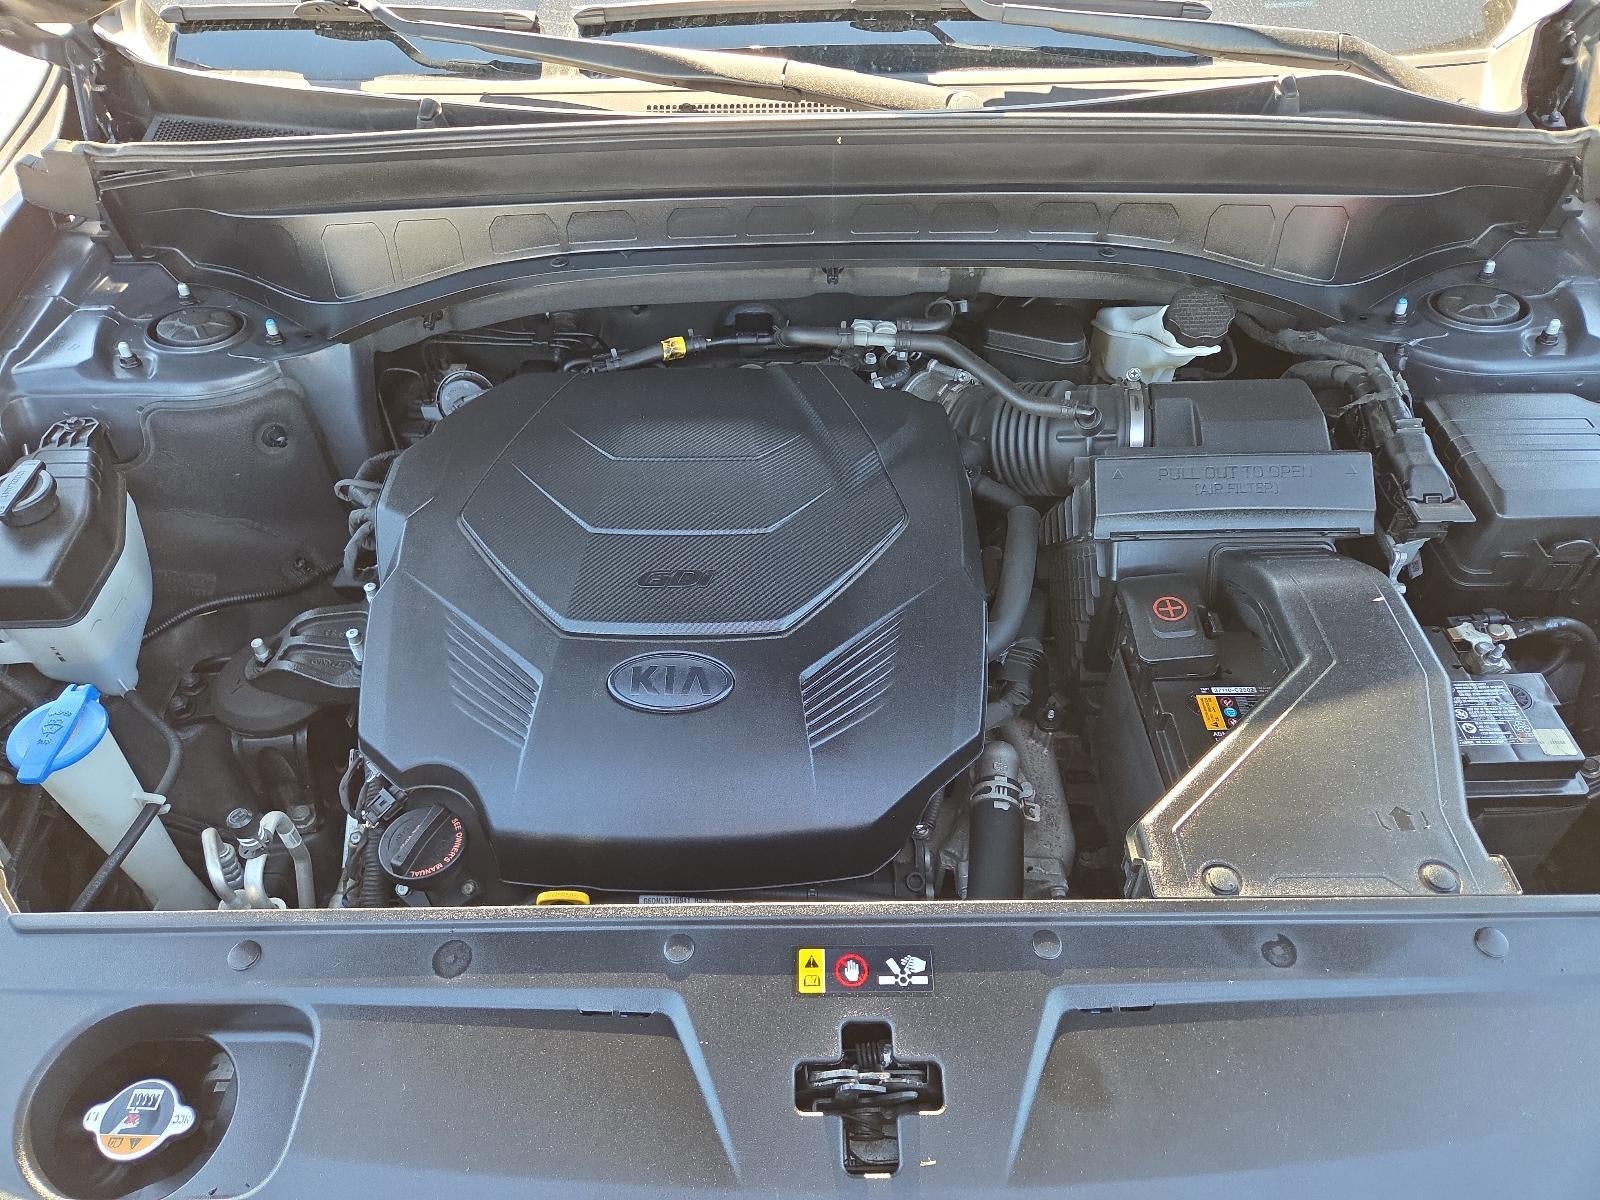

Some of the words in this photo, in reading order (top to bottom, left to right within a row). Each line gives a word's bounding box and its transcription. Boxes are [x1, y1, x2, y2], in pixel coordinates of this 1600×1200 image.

[1158, 467, 1201, 481] PULL
[1204, 466, 1237, 479] OUT
[1245, 465, 1264, 478] TO
[1268, 465, 1313, 478] OPEN
[630, 665, 712, 696] KIA
[451, 818, 462, 831] SEE
[443, 832, 463, 863] OWNER'S
[410, 862, 444, 878] MANUAL
